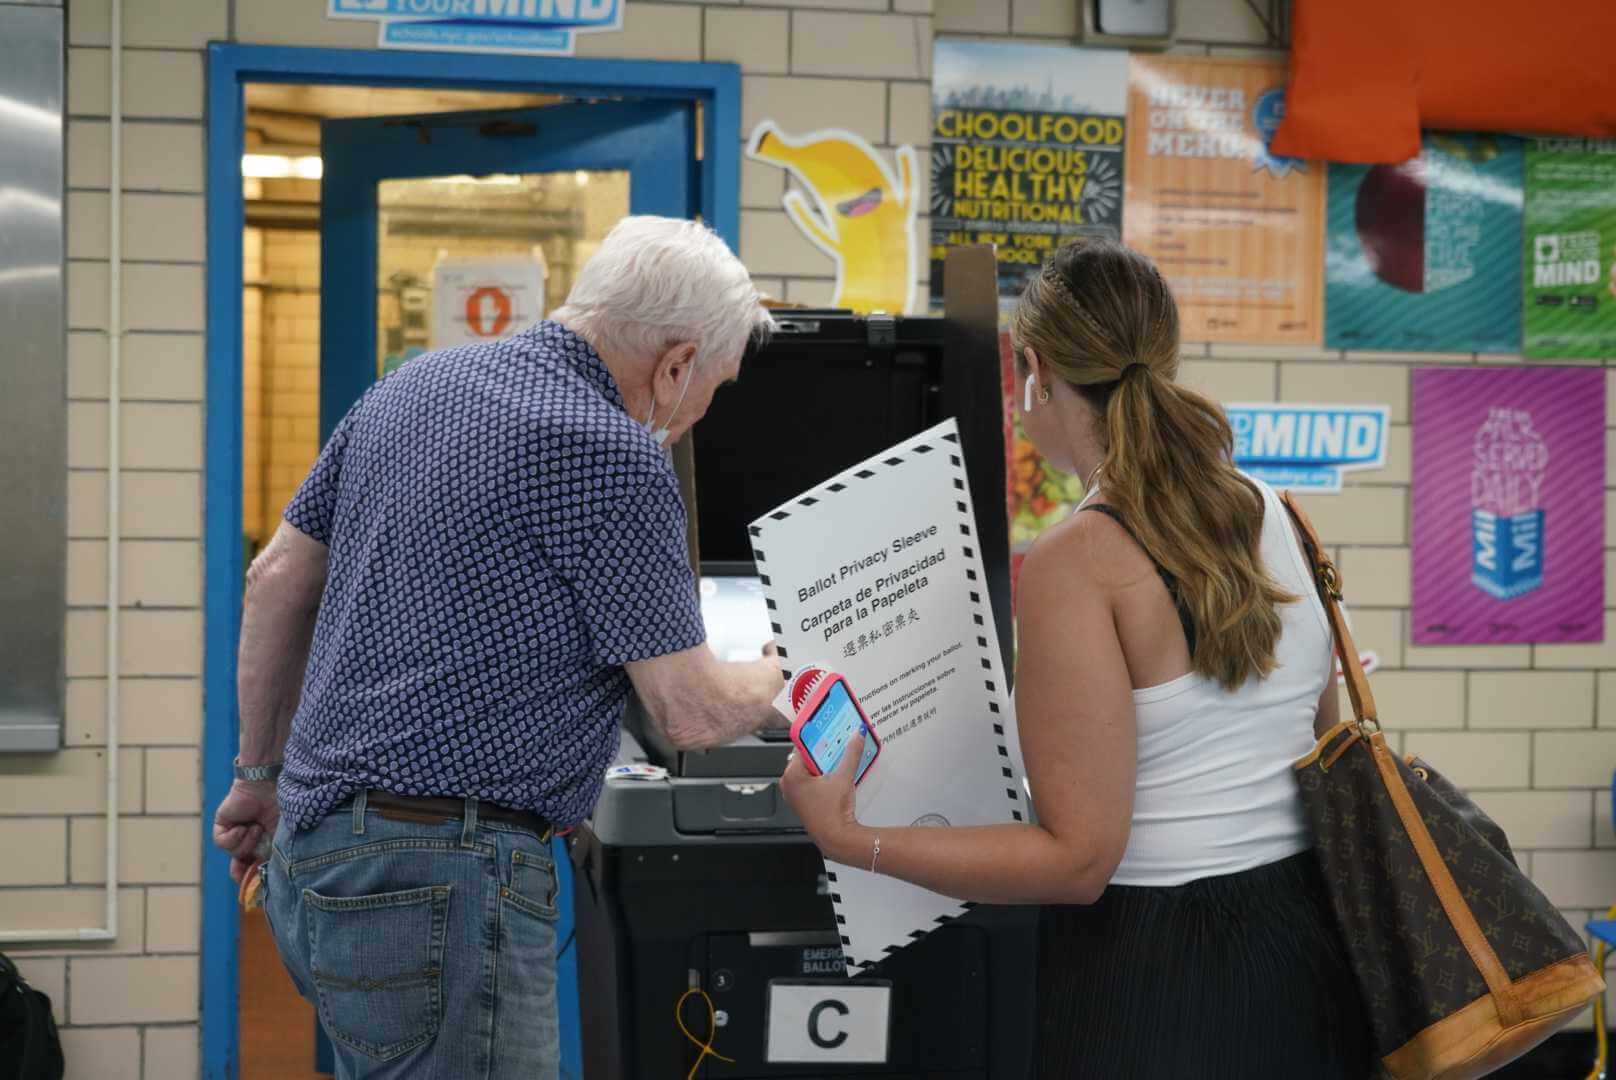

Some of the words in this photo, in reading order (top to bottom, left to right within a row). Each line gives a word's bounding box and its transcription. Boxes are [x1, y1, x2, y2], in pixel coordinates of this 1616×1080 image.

[954, 145, 1087, 175] DELICIOUS
[953, 172, 1086, 202] HEALTHY
[953, 199, 1083, 224] NUTRITIONAL
[1013, 235, 1052, 249] YORK
[1535, 259, 1601, 287] MIND
[1252, 413, 1378, 458] MIND
[1471, 469, 1545, 510] DAILY
[796, 572, 837, 603] Ballot
[840, 547, 889, 581] Privacy
[891, 523, 938, 554] Sleeve
[800, 598, 853, 633] Carpeta
[855, 585, 873, 604] de
[875, 548, 947, 593] Privacidad
[823, 616, 854, 641] para
[856, 606, 869, 621] la
[871, 574, 929, 613] Papeleta
[858, 683, 889, 704] tructions
[889, 677, 899, 687] on
[899, 661, 926, 681] marking
[927, 653, 942, 667] your
[892, 678, 936, 706] instrucciones
[936, 667, 956, 681] sobre
[802, 948, 844, 960] EMERG
[807, 999, 849, 1049] C
